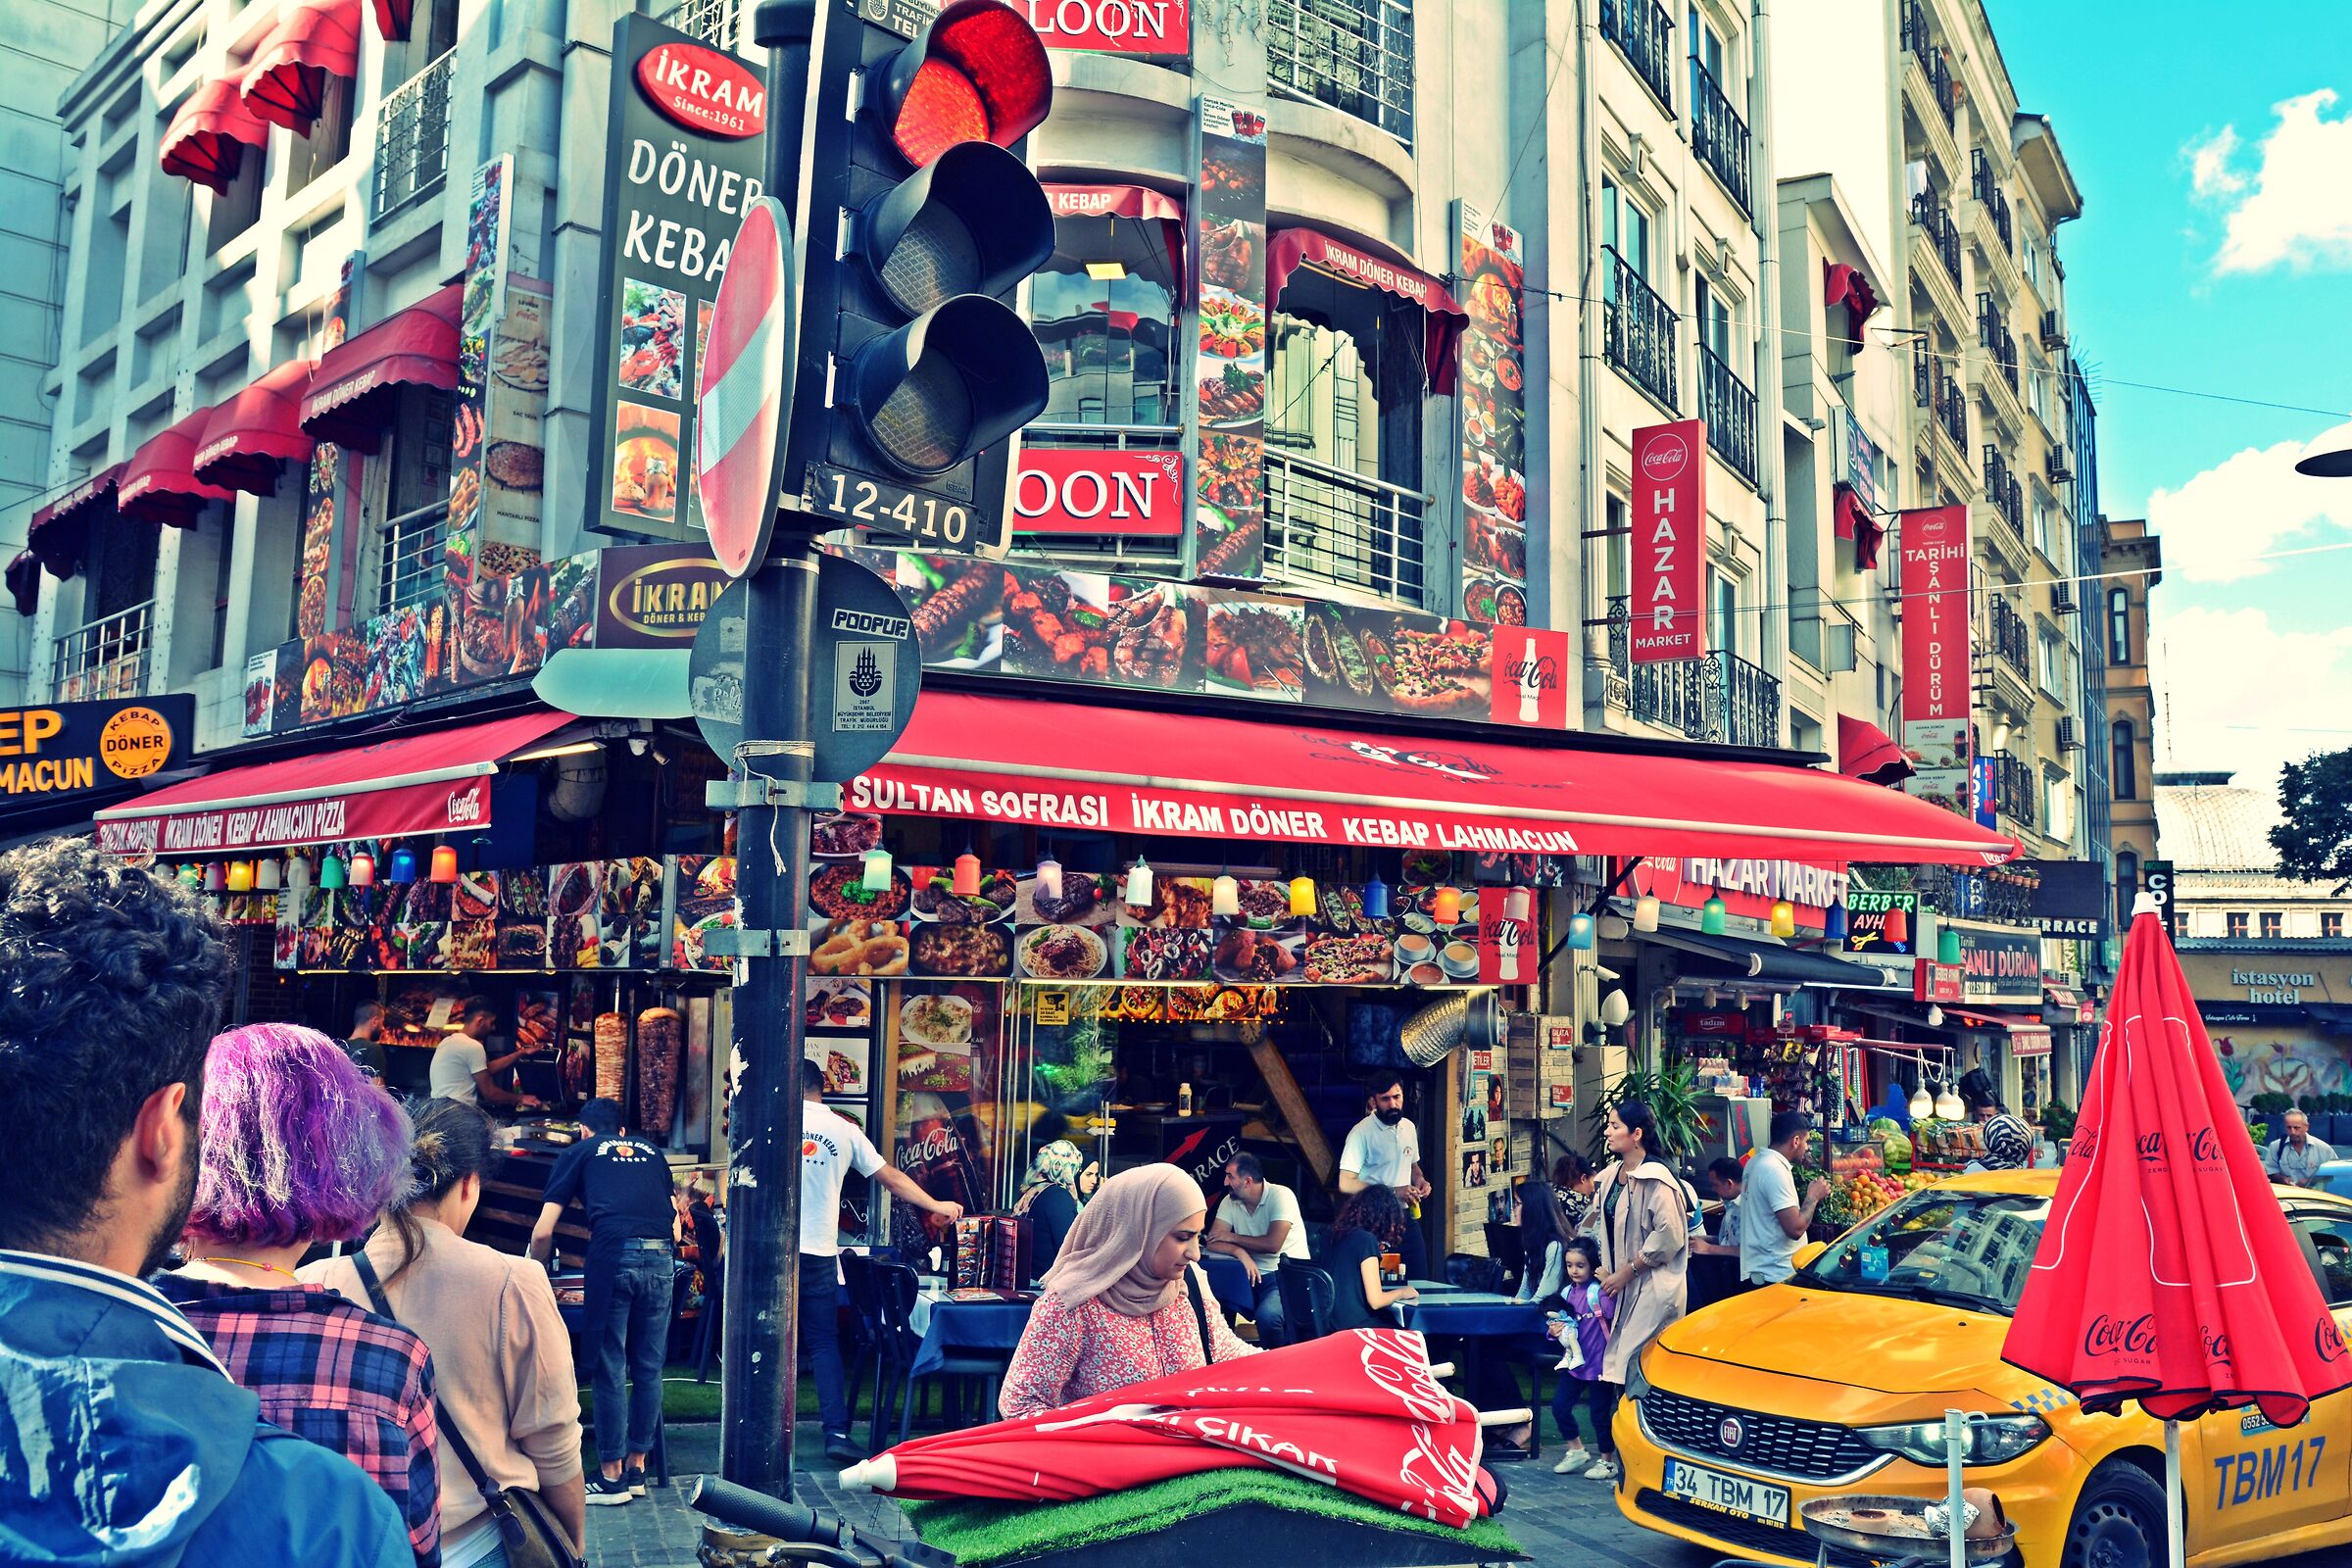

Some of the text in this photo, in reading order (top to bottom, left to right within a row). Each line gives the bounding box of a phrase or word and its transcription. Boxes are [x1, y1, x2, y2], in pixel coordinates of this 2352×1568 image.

[656, 49, 763, 118] İKRAM
[628, 139, 762, 220] DÖNER
[1058, 193, 1112, 210] KEBAP
[1325, 240, 1427, 299] İKRAM DÖNER KEBAP
[829, 474, 967, 544] 12-410
[1652, 488, 1677, 631] HAZAR
[1905, 543, 1965, 563] TARİHİ
[643, 612, 675, 624] DÖNER
[1636, 633, 1691, 650] MARKET
[1929, 642, 1943, 716] DÜRÜM
[110, 711, 160, 731] KEBAP
[107, 735, 165, 752] DÖNER
[165, 814, 194, 850] İKRAM
[194, 811, 224, 848] DÖNER
[225, 809, 258, 846] KEBAP
[255, 802, 316, 843] LAHMACUN
[314, 798, 346, 837] PİZZA
[851, 774, 1579, 853] SULTAN SOFRASI İKRAM DÖNER KEBAP LAHMACUN
[1690, 858, 1850, 909] HAZAR MARKET
[1848, 893, 1914, 913] BERBER
[1853, 914, 1886, 930] AYH
[1998, 944, 2038, 979] DÜRÜM
[2231, 968, 2315, 989] istasyon
[2249, 988, 2300, 1004] hotel
[1723, 1424, 1737, 1441] FIAT
[2242, 1414, 2261, 1430] 0552
[1675, 1466, 1697, 1494] 34
[1707, 1474, 1753, 1510] TBM
[1763, 1490, 1786, 1517] 17
[1689, 1497, 1749, 1519] SERKAN OTO
